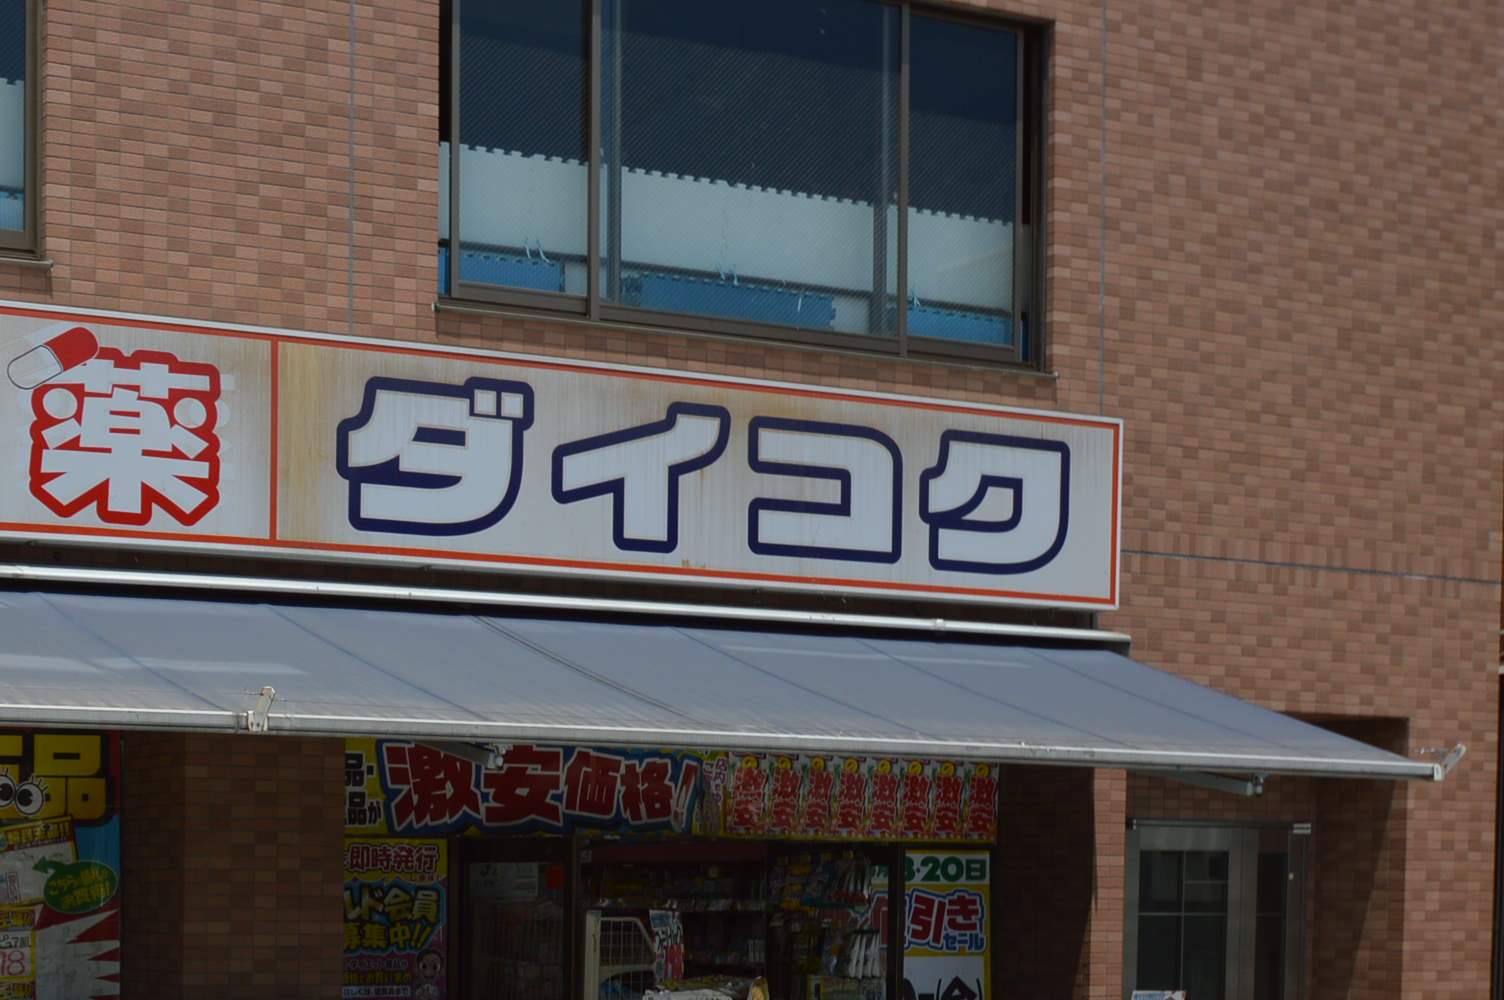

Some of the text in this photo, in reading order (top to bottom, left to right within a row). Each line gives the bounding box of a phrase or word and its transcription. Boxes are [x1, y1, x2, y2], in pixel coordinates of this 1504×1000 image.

[27, 346, 223, 527] 薬
[336, 374, 1072, 577] ダイコク
